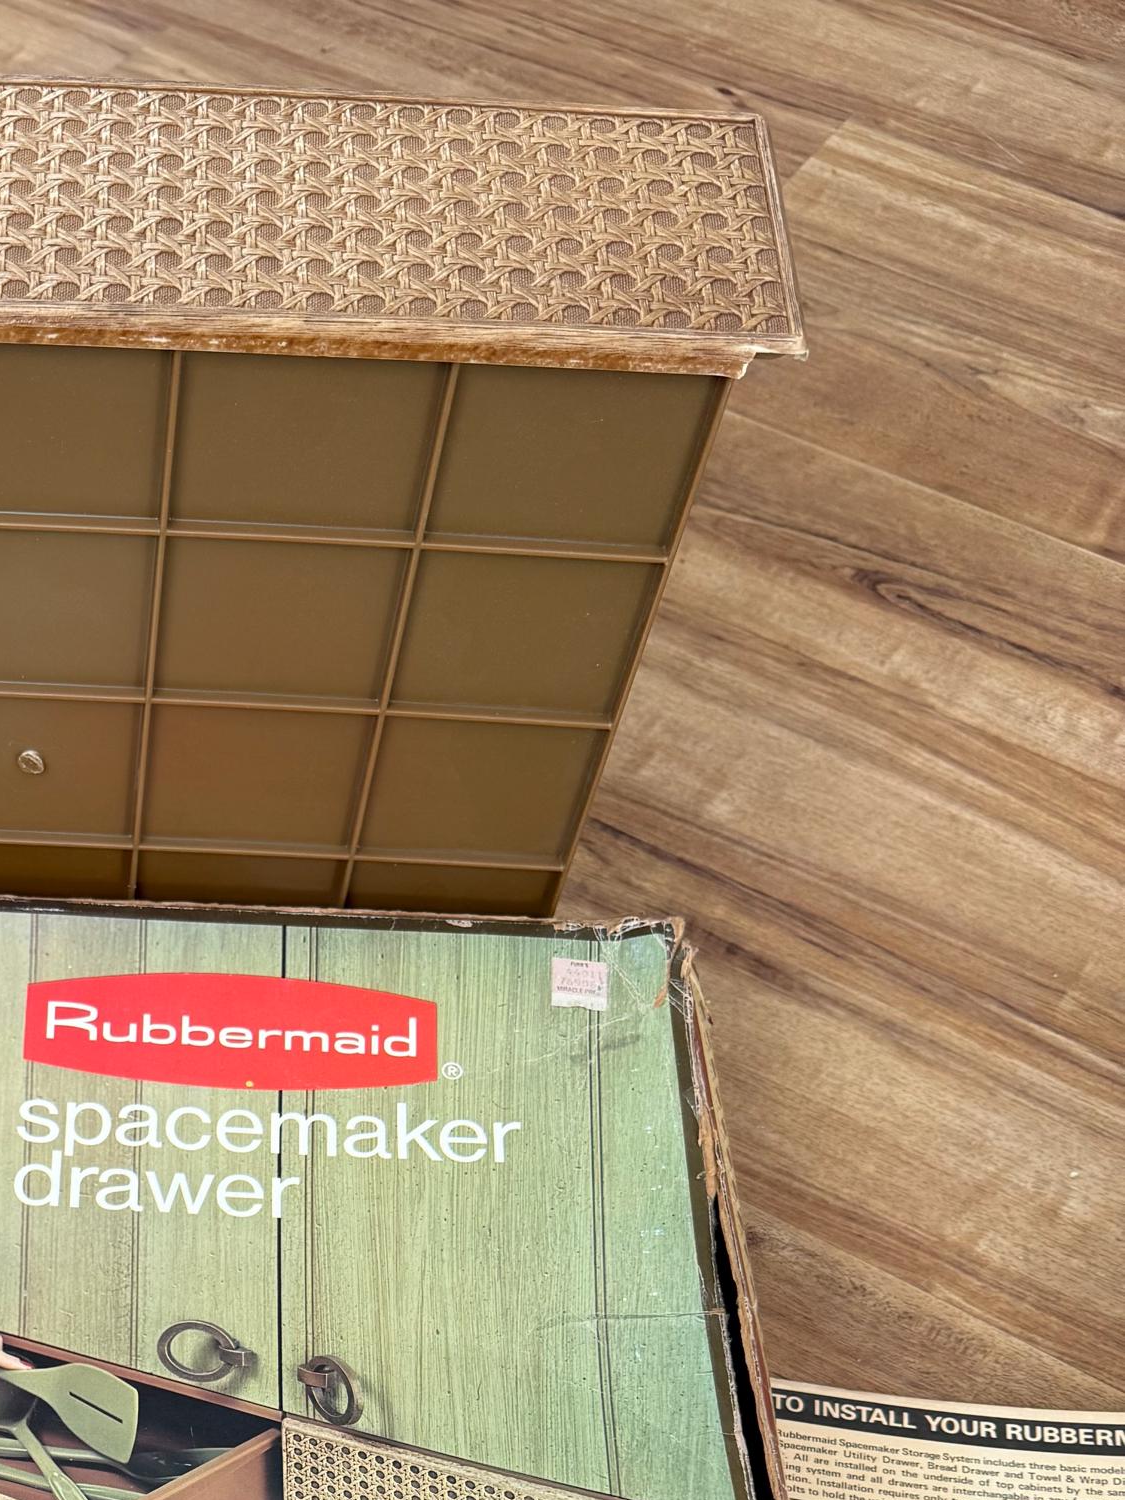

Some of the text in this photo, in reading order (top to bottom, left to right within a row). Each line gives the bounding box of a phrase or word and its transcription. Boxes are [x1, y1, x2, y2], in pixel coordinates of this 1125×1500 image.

[45, 1000, 417, 1058] Rubbermaid
[16, 1098, 521, 1164] spacemaker
[13, 1150, 301, 1219] drawer
[772, 1393, 804, 1413] TO
[815, 1400, 917, 1429] INSTALL
[924, 1414, 997, 1438] YOUR
